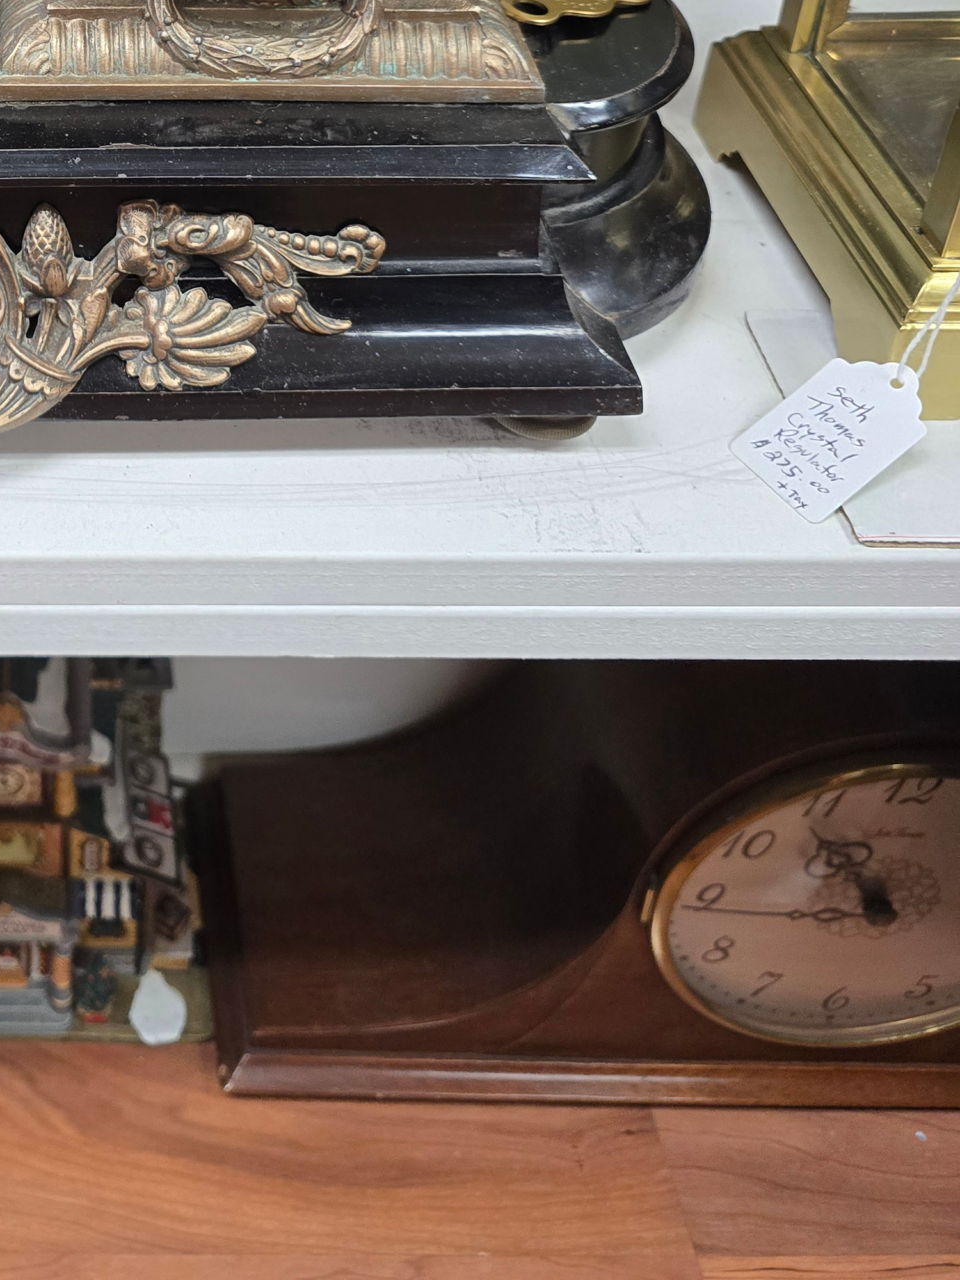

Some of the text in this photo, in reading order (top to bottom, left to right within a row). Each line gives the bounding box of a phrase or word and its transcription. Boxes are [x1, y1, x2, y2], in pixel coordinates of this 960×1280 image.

[827, 386, 875, 424] Seth
[807, 395, 866, 448] Thomas
[787, 412, 859, 463] Crystal
[773, 427, 844, 483] Regulator
[722, 829, 776, 860] 10
[696, 882, 726, 911] 9
[701, 935, 735, 964] 8
[751, 970, 783, 997] 7
[904, 974, 938, 1000] 5
[822, 986, 849, 1012] 6
